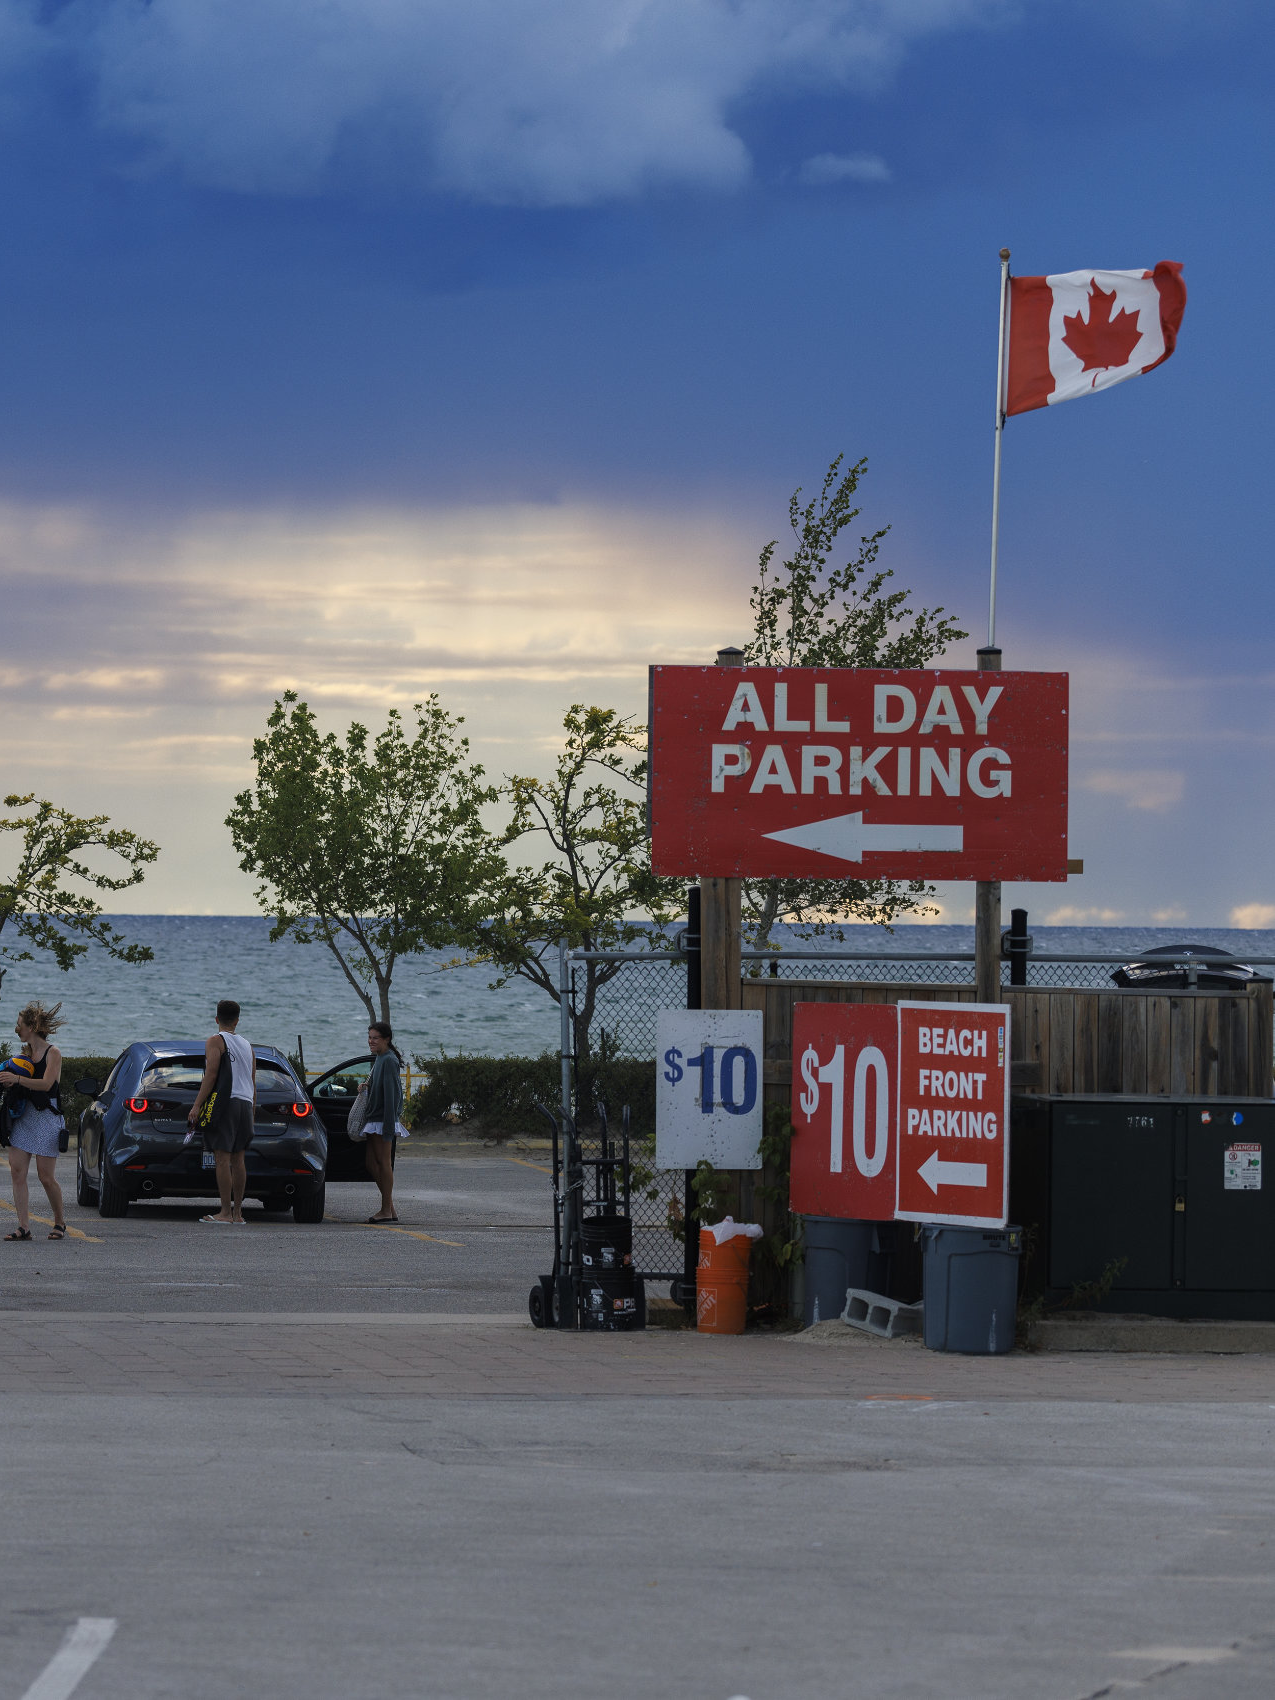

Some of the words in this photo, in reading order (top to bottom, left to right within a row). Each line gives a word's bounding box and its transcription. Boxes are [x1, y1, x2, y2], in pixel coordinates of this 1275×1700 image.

[721, 681, 851, 734] ALL
[873, 684, 1005, 736] DAY
[711, 743, 1013, 799] PARKING
[918, 1026, 988, 1058] BEACH
[664, 1045, 758, 1116] $10
[918, 1067, 987, 1100] FRONT
[799, 1043, 889, 1178] $10
[907, 1108, 997, 1141] PARKING
